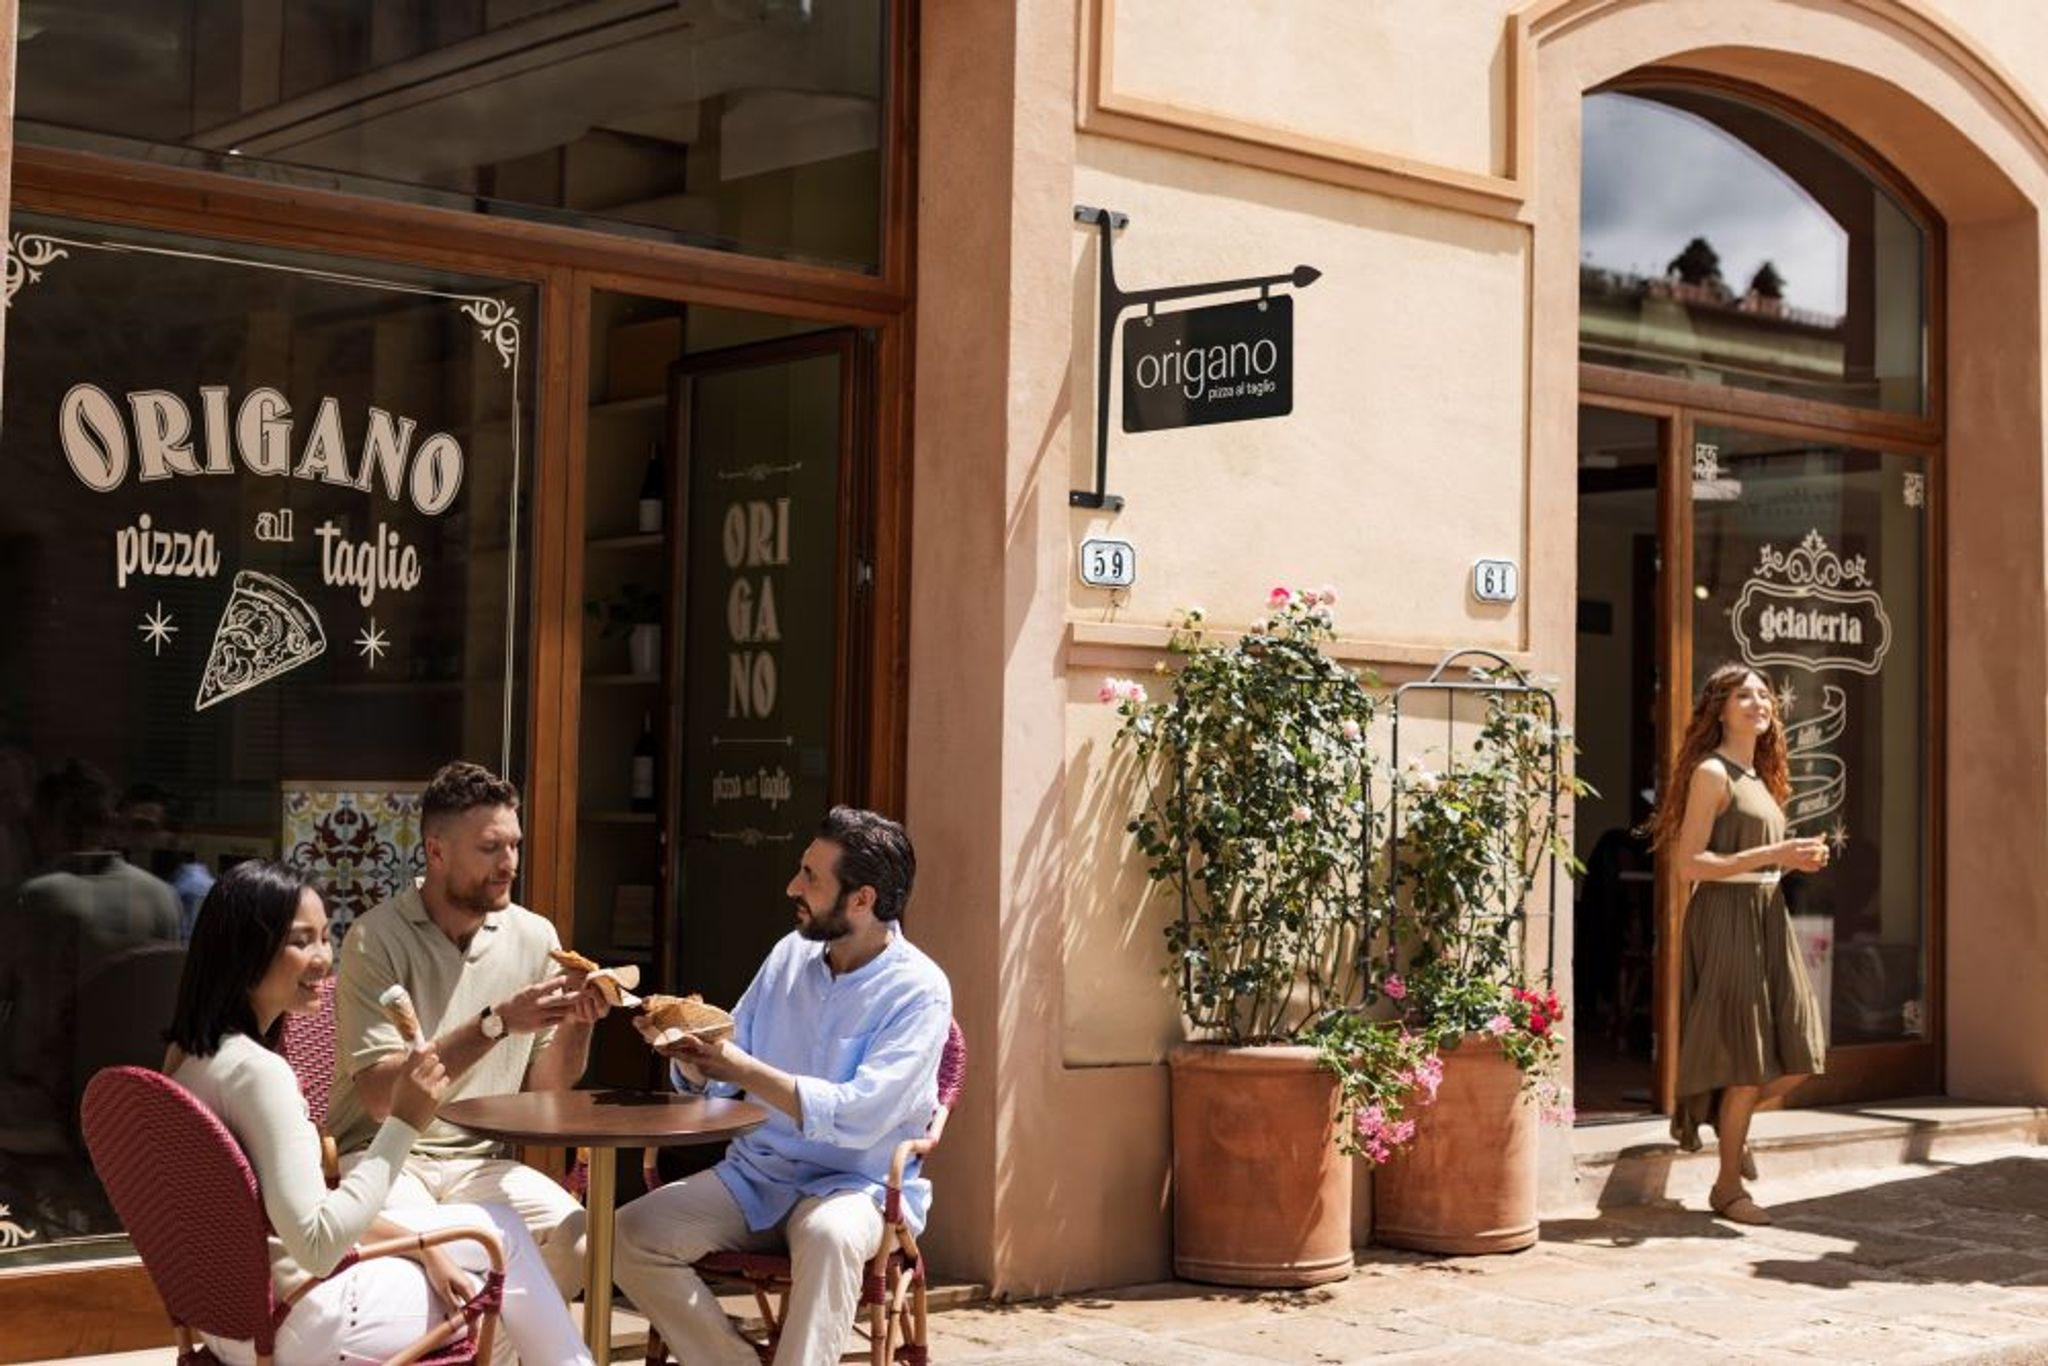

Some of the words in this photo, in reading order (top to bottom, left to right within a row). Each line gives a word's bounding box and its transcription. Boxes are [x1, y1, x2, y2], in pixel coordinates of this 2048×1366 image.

[1136, 339, 1277, 399] origano
[1208, 385, 1233, 401] pizza
[1235, 380, 1245, 396] al
[1247, 379, 1275, 396] taglio
[59, 382, 464, 516] ORIGANO
[116, 513, 220, 589] pizza
[255, 509, 293, 542] al
[315, 519, 421, 607] taglio
[723, 497, 791, 568] ORI
[1094, 550, 1123, 578] 59
[727, 575, 781, 644] GA
[1485, 566, 1506, 593] 61
[1760, 604, 1862, 644] gelateria
[729, 651, 778, 718] NO
